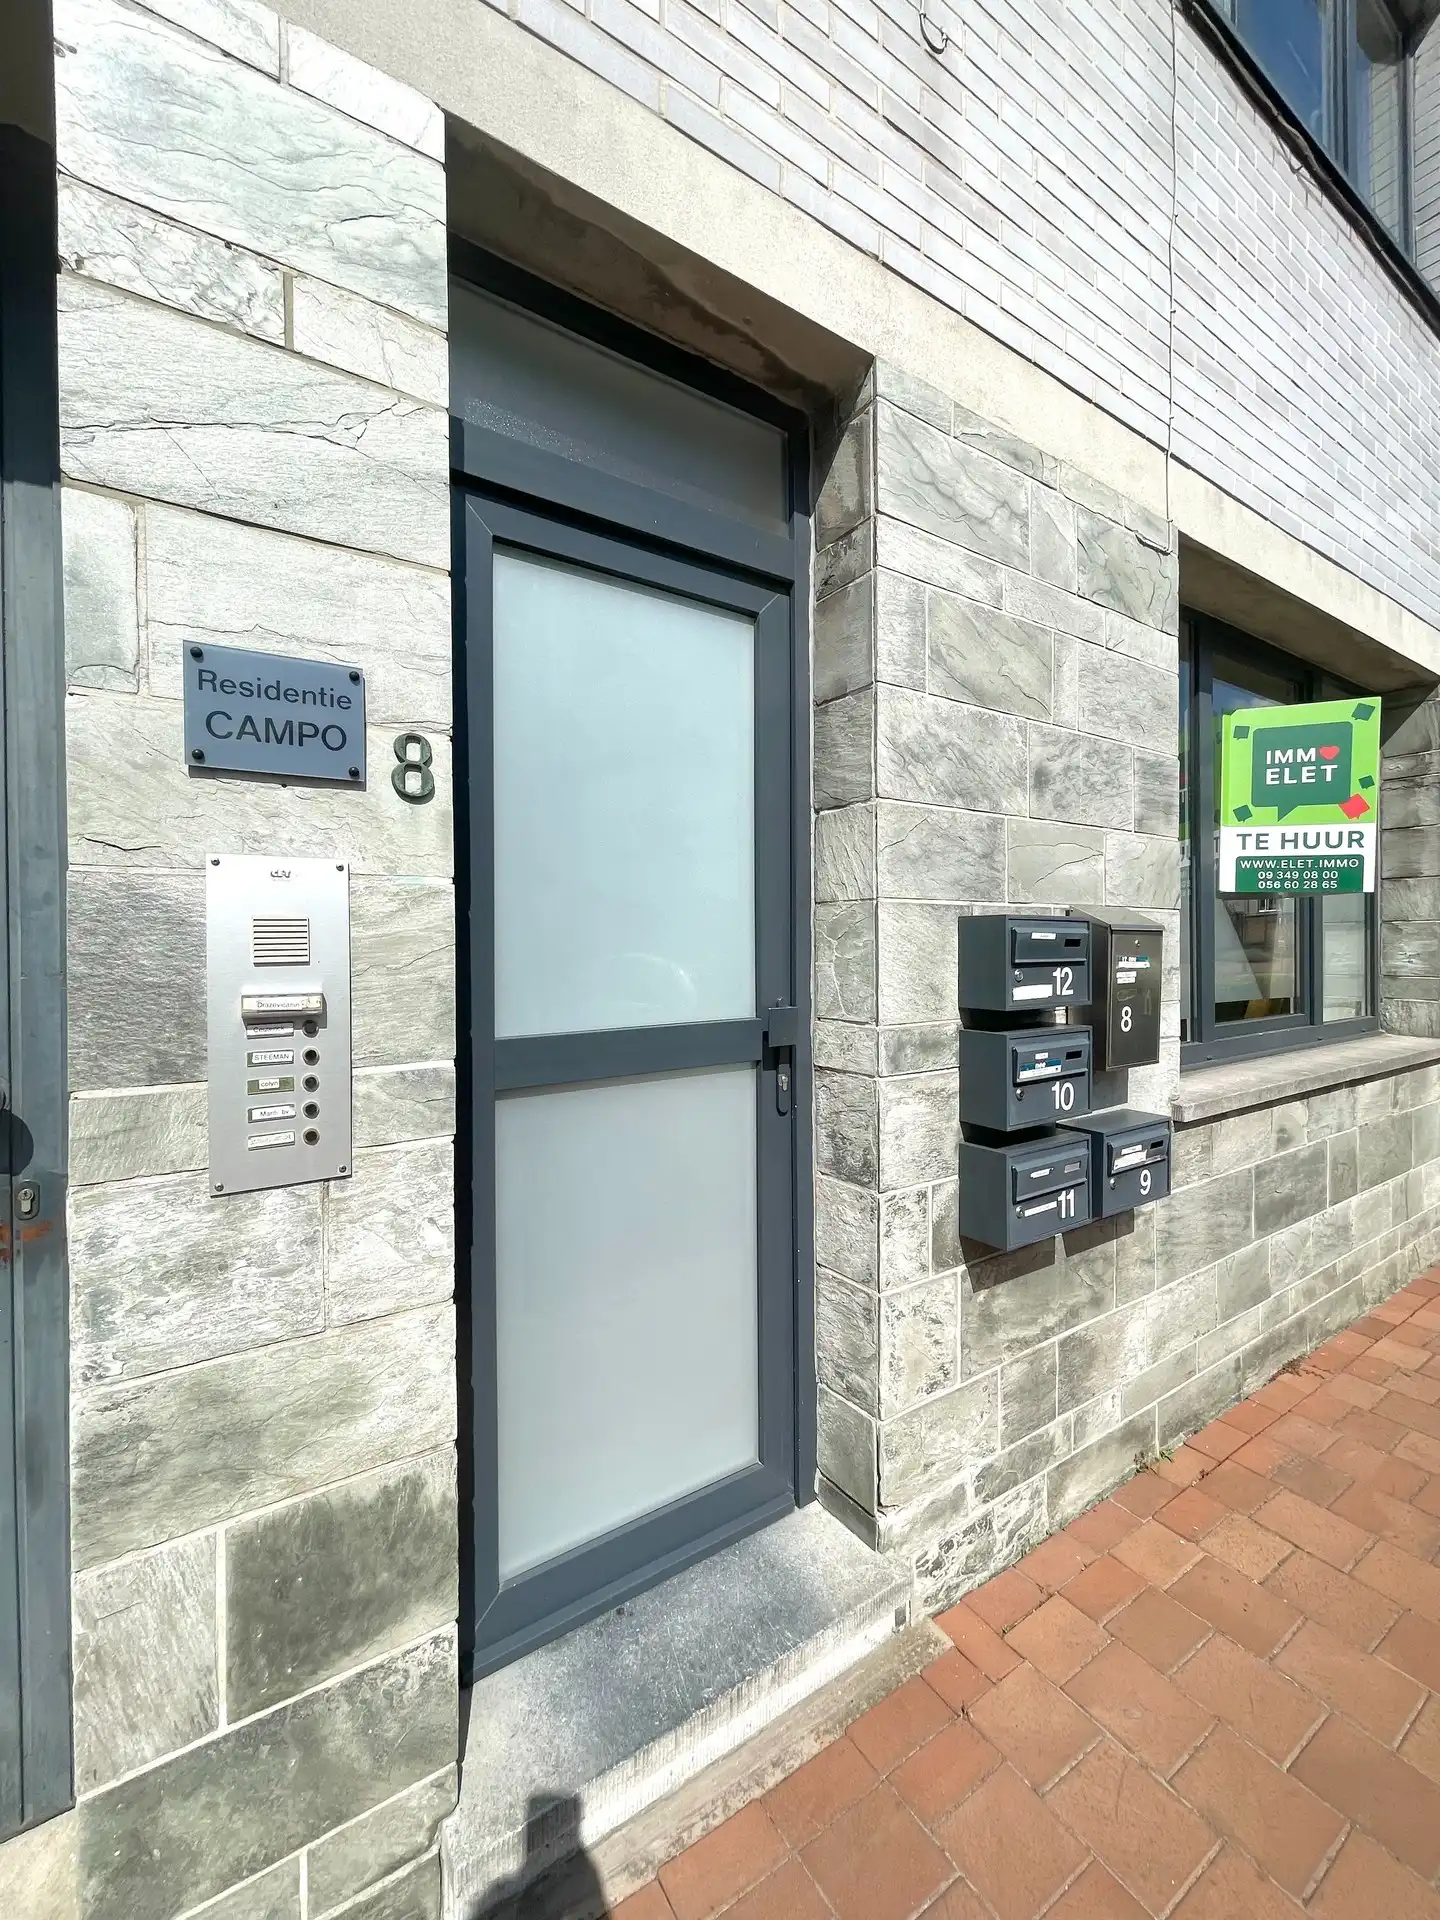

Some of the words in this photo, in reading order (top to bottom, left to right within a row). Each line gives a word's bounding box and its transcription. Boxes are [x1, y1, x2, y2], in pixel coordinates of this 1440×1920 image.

[197, 668, 353, 710] Residentie
[205, 710, 347, 751] CAMPO
[391, 732, 435, 799] 8
[1265, 764, 1338, 785] ELET
[1236, 833, 1270, 850] TE
[1280, 830, 1365, 850] HUUR
[1240, 858, 1359, 869] WWW.ELET.IMMO
[1258, 870, 1274, 880] 09
[1276, 870, 1299, 879] 349
[1303, 870, 1318, 879] 08
[1322, 870, 1338, 879] 00
[1258, 881, 1281, 889] 056
[1284, 881, 1299, 889] 60
[1303, 880, 1318, 889] 28
[1322, 880, 1337, 889] 65
[1052, 966, 1074, 996] 12
[1120, 1005, 1132, 1032] 8
[254, 1052, 290, 1061] STEEMAN
[1051, 1080, 1075, 1111] 10
[1139, 1169, 1152, 1195] 9
[1057, 1188, 1075, 1219] 11
